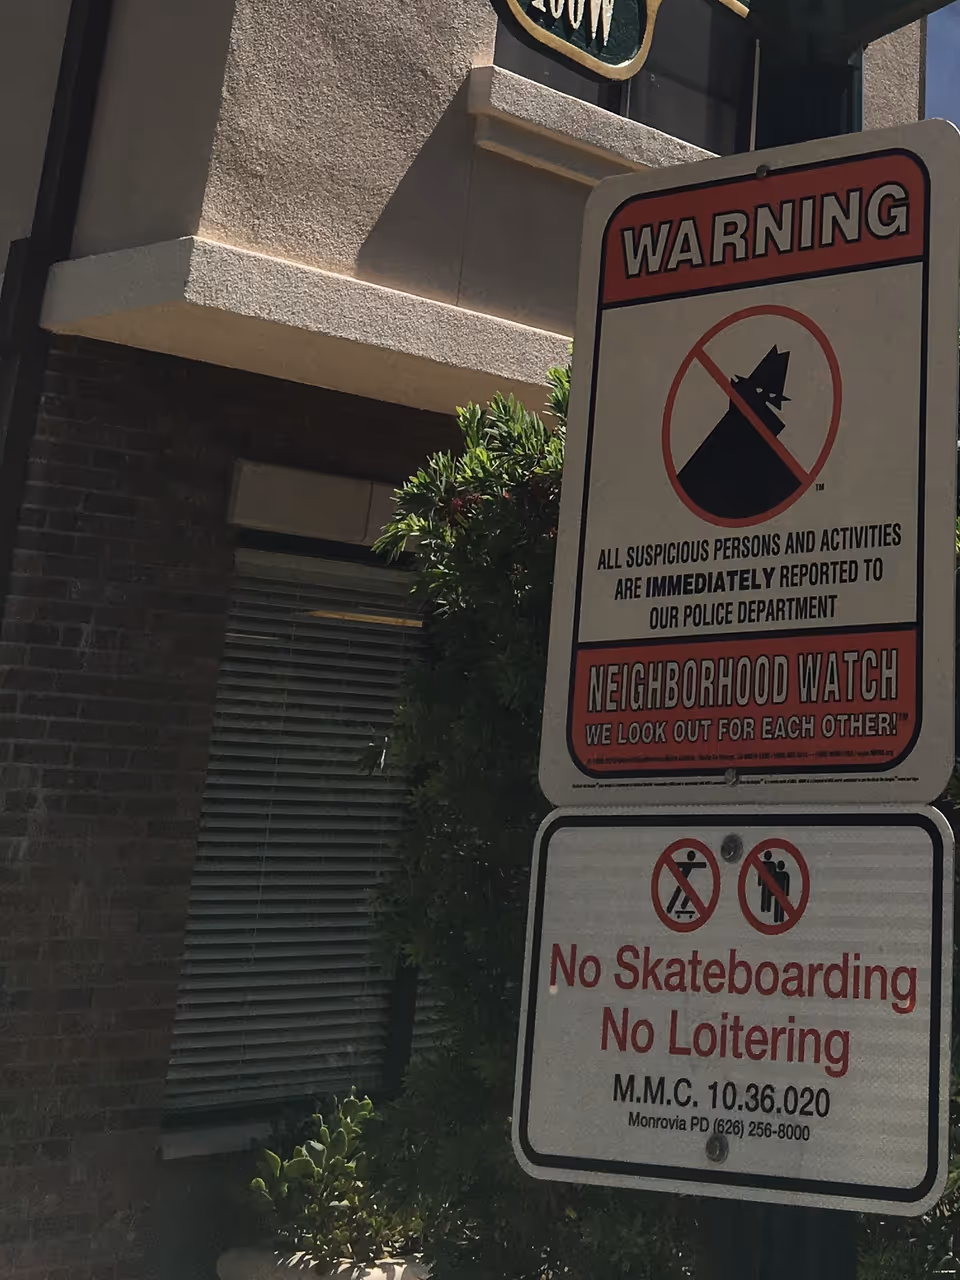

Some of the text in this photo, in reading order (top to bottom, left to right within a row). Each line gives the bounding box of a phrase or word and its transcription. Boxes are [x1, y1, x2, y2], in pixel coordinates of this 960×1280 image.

[621, 181, 911, 280] WARNING
[597, 522, 902, 571] ALL SUSPICIOUS PERSONS AND ACTIVITIES
[614, 557, 884, 601] ARE IMMEDIATELY REPORTED TO
[649, 594, 838, 630] OUR POLICE DEPARTMENT
[587, 648, 899, 713] NEIGHBORHOOD WATCH
[585, 723, 612, 746] WE
[616, 720, 667, 745] LOOK
[673, 719, 712, 742] OUT
[717, 716, 755, 741] FOR
[761, 715, 815, 740] EACH
[821, 712, 899, 738] OTHER!
[549, 943, 918, 1015] No Skateboarding
[600, 1006, 851, 1078] No Loitering
[612, 1073, 831, 1118] M.M.C. 10.36.020
[628, 1111, 811, 1142] Monrovia PD (626) 256-8000
